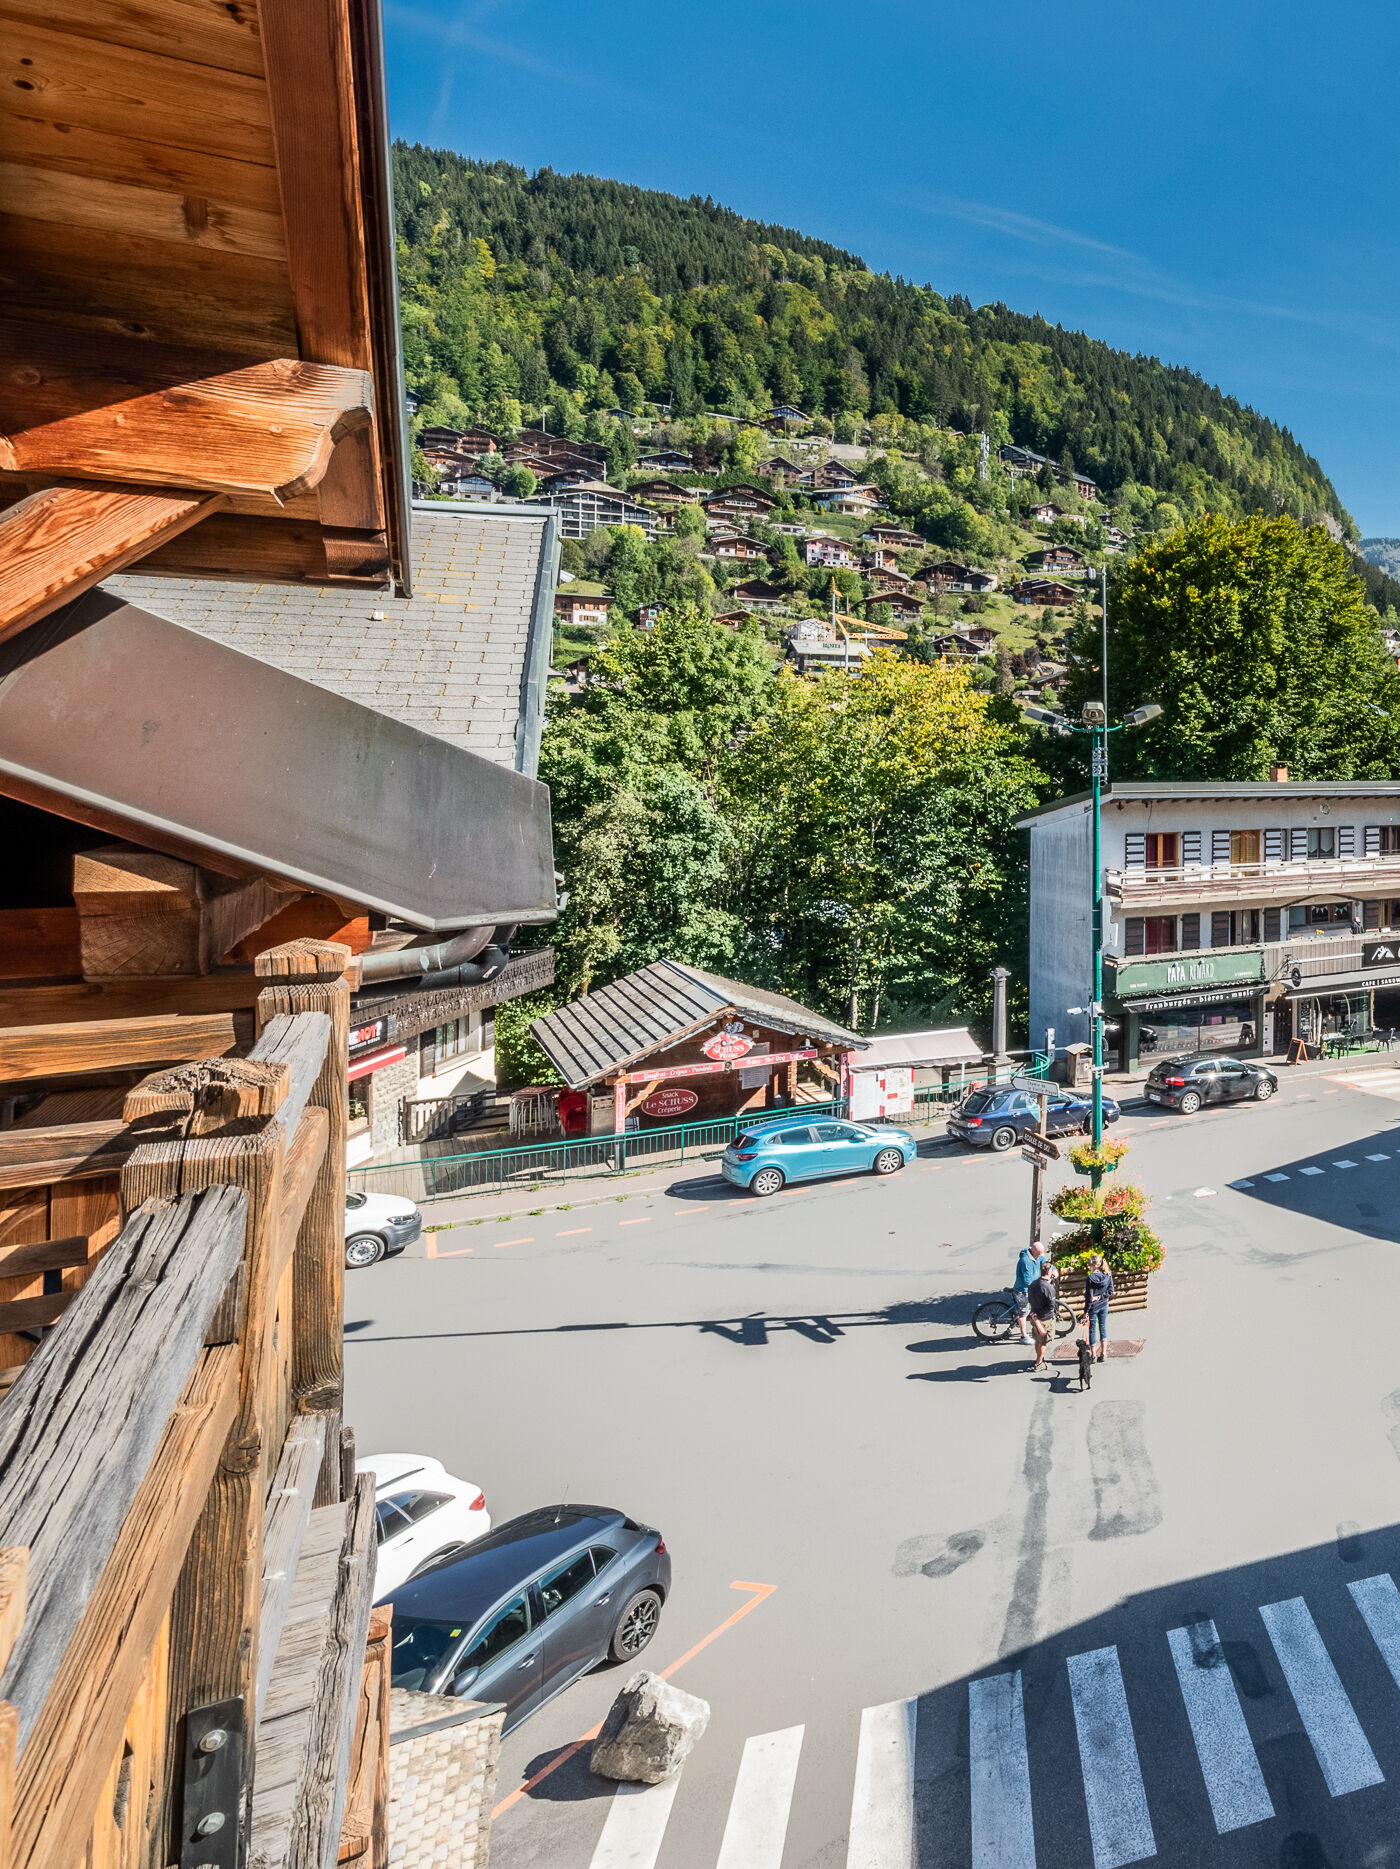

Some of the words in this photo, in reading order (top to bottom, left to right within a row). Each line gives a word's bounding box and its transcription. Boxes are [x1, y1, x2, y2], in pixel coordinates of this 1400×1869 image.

[1167, 965, 1186, 983] PAPA
[1189, 962, 1215, 981] RENARD
[1231, 989, 1254, 998] music
[662, 1091, 679, 1099] Snack
[645, 1101, 657, 1109] Le
[658, 1096, 694, 1106] SCHUSS
[1024, 1133, 1038, 1146] ECOLES
